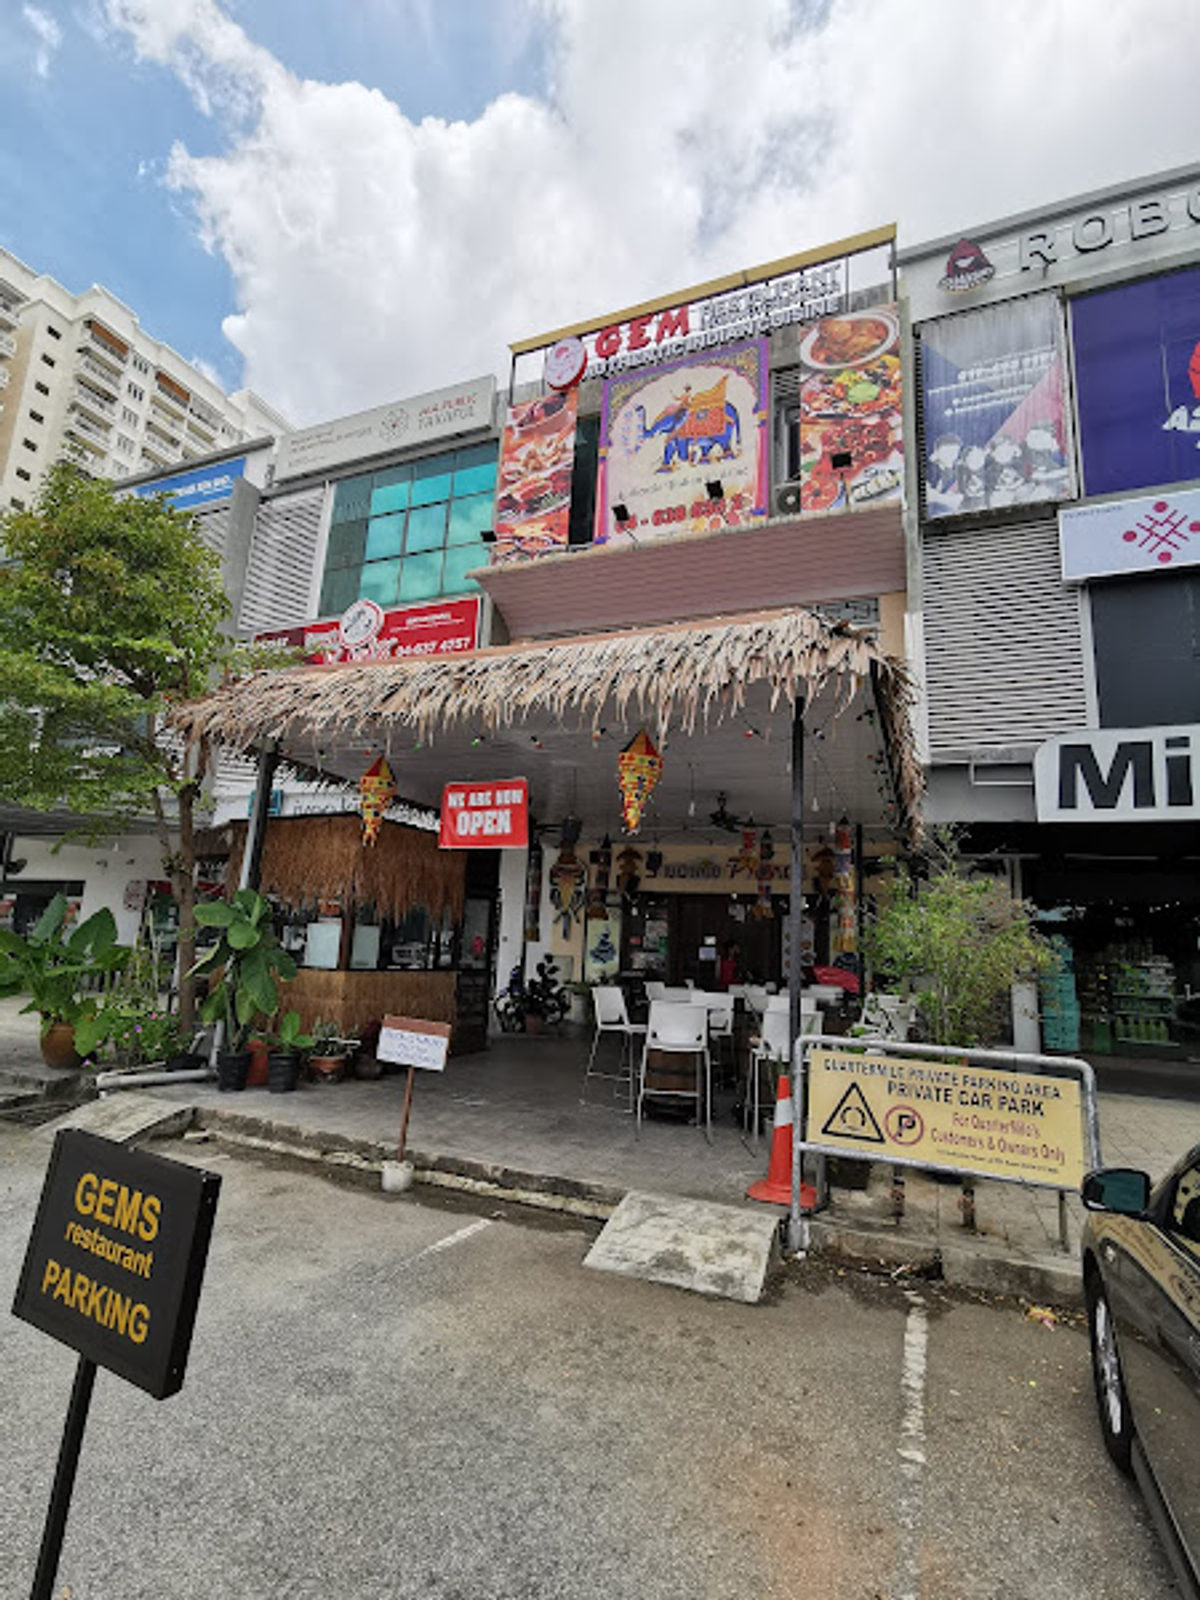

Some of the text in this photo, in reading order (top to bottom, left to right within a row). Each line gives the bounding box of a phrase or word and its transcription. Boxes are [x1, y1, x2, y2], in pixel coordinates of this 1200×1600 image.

[583, 341, 686, 380] AUTHENTIC
[687, 322, 753, 350] INDIAN
[756, 300, 840, 332] CUISINE
[594, 305, 690, 359] GEM
[448, 789, 524, 809] WE ARE NOW
[456, 809, 512, 836] OPEN
[888, 1080, 1045, 1117] PRIVATE CAR PARK
[909, 1067, 959, 1087] PRIVATE
[962, 1075, 1020, 1095] PARKING
[1024, 1082, 1062, 1099] AREA
[952, 1112, 969, 1127] For
[930, 1127, 984, 1149] Customers
[987, 1136, 996, 1151] &
[997, 1138, 1039, 1159] Owners
[1040, 1143, 1066, 1166] Only
[74, 1173, 162, 1242] GEMS
[64, 1221, 154, 1279] restaurant
[41, 1258, 150, 1344] PARKING
